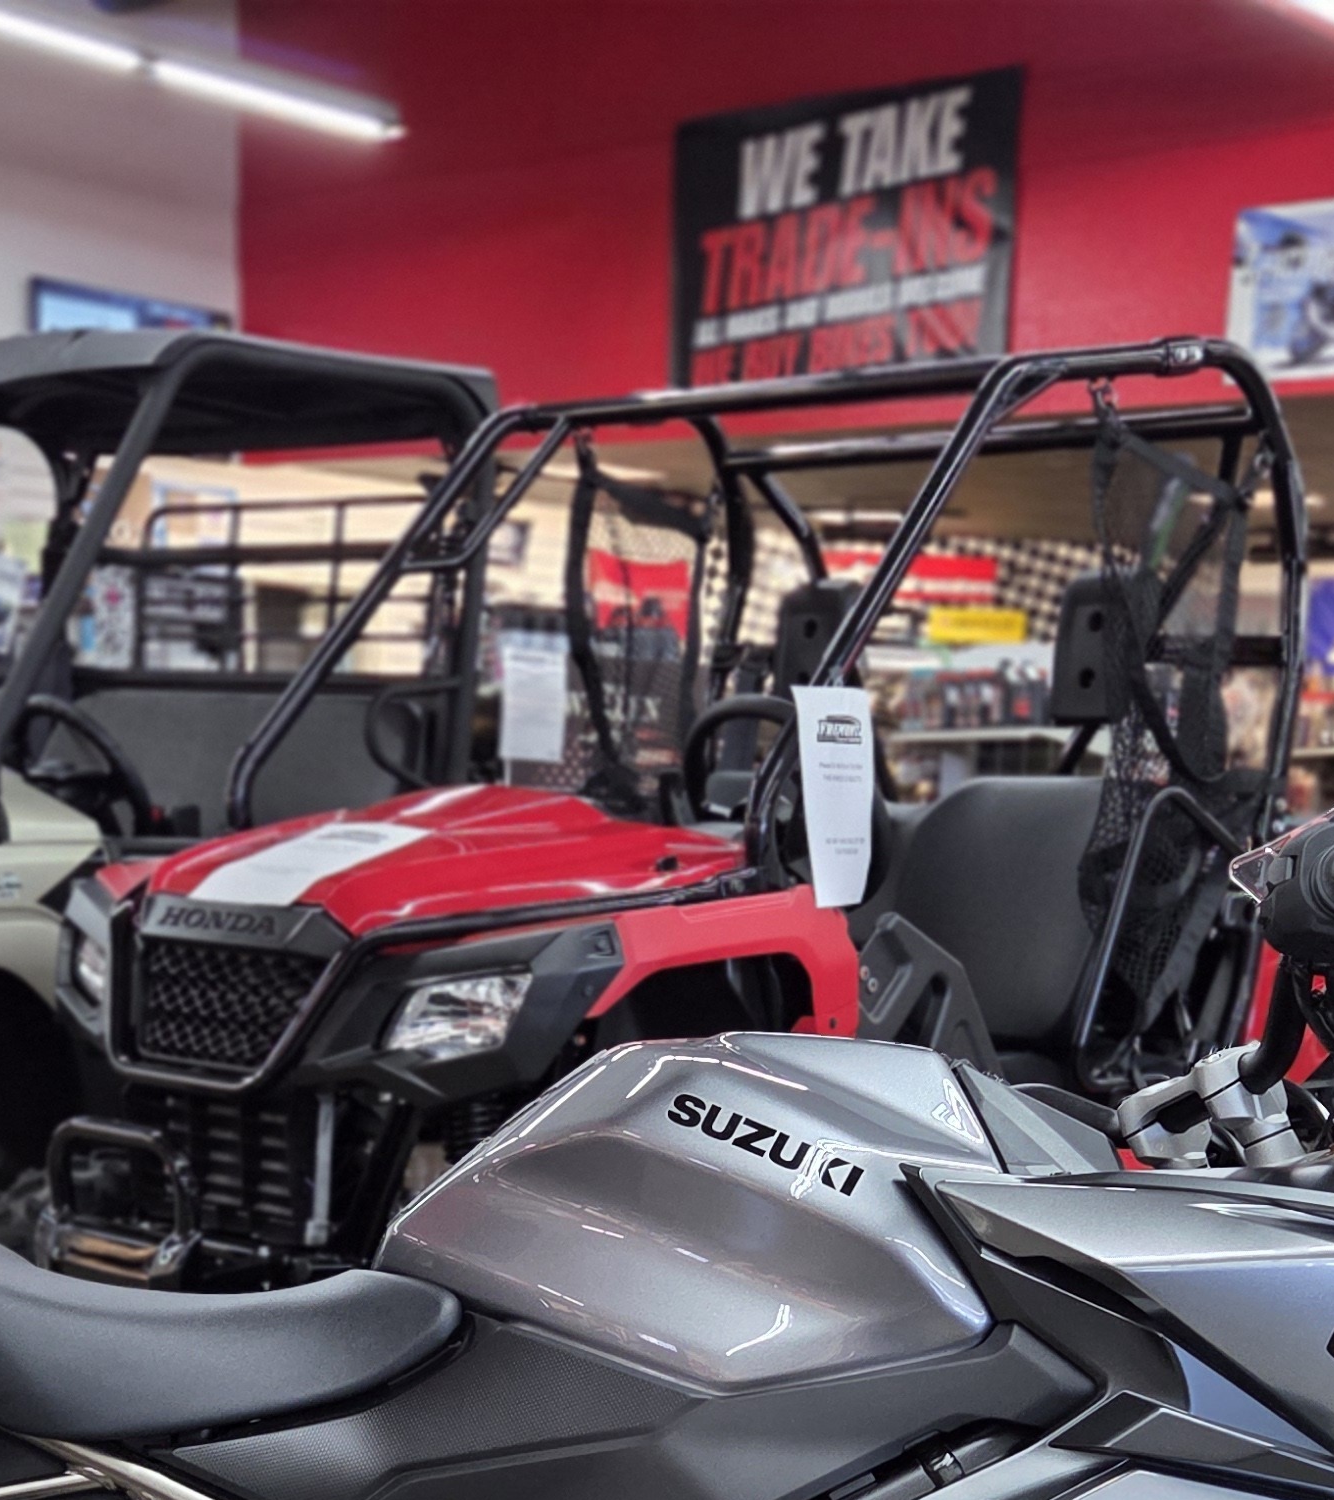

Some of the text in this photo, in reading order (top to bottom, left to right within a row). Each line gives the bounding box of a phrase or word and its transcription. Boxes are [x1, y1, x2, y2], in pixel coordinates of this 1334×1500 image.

[738, 86, 973, 221] WE TAKE
[700, 167, 997, 317] TRADE-INS
[159, 905, 277, 937] HONDA
[667, 1093, 865, 1197] SUZUKI
